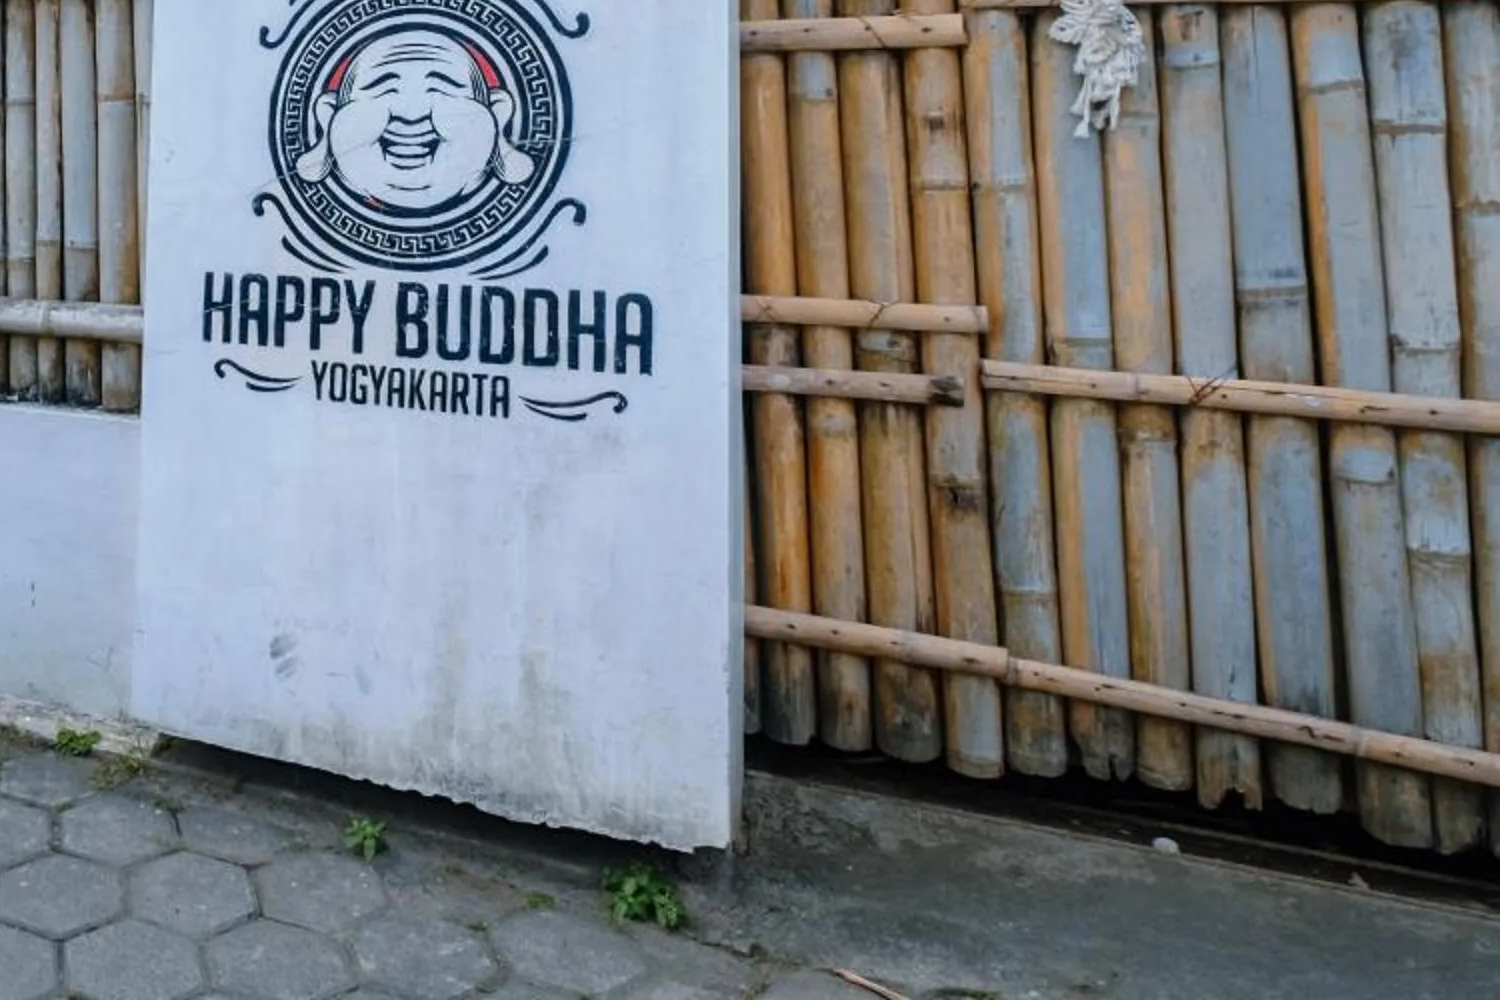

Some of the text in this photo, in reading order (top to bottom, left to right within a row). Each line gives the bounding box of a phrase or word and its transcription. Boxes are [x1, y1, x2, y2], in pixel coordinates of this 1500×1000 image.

[202, 272, 654, 376] HAPPY BUDDHA
[311, 359, 510, 418] YOGYAKARTA
